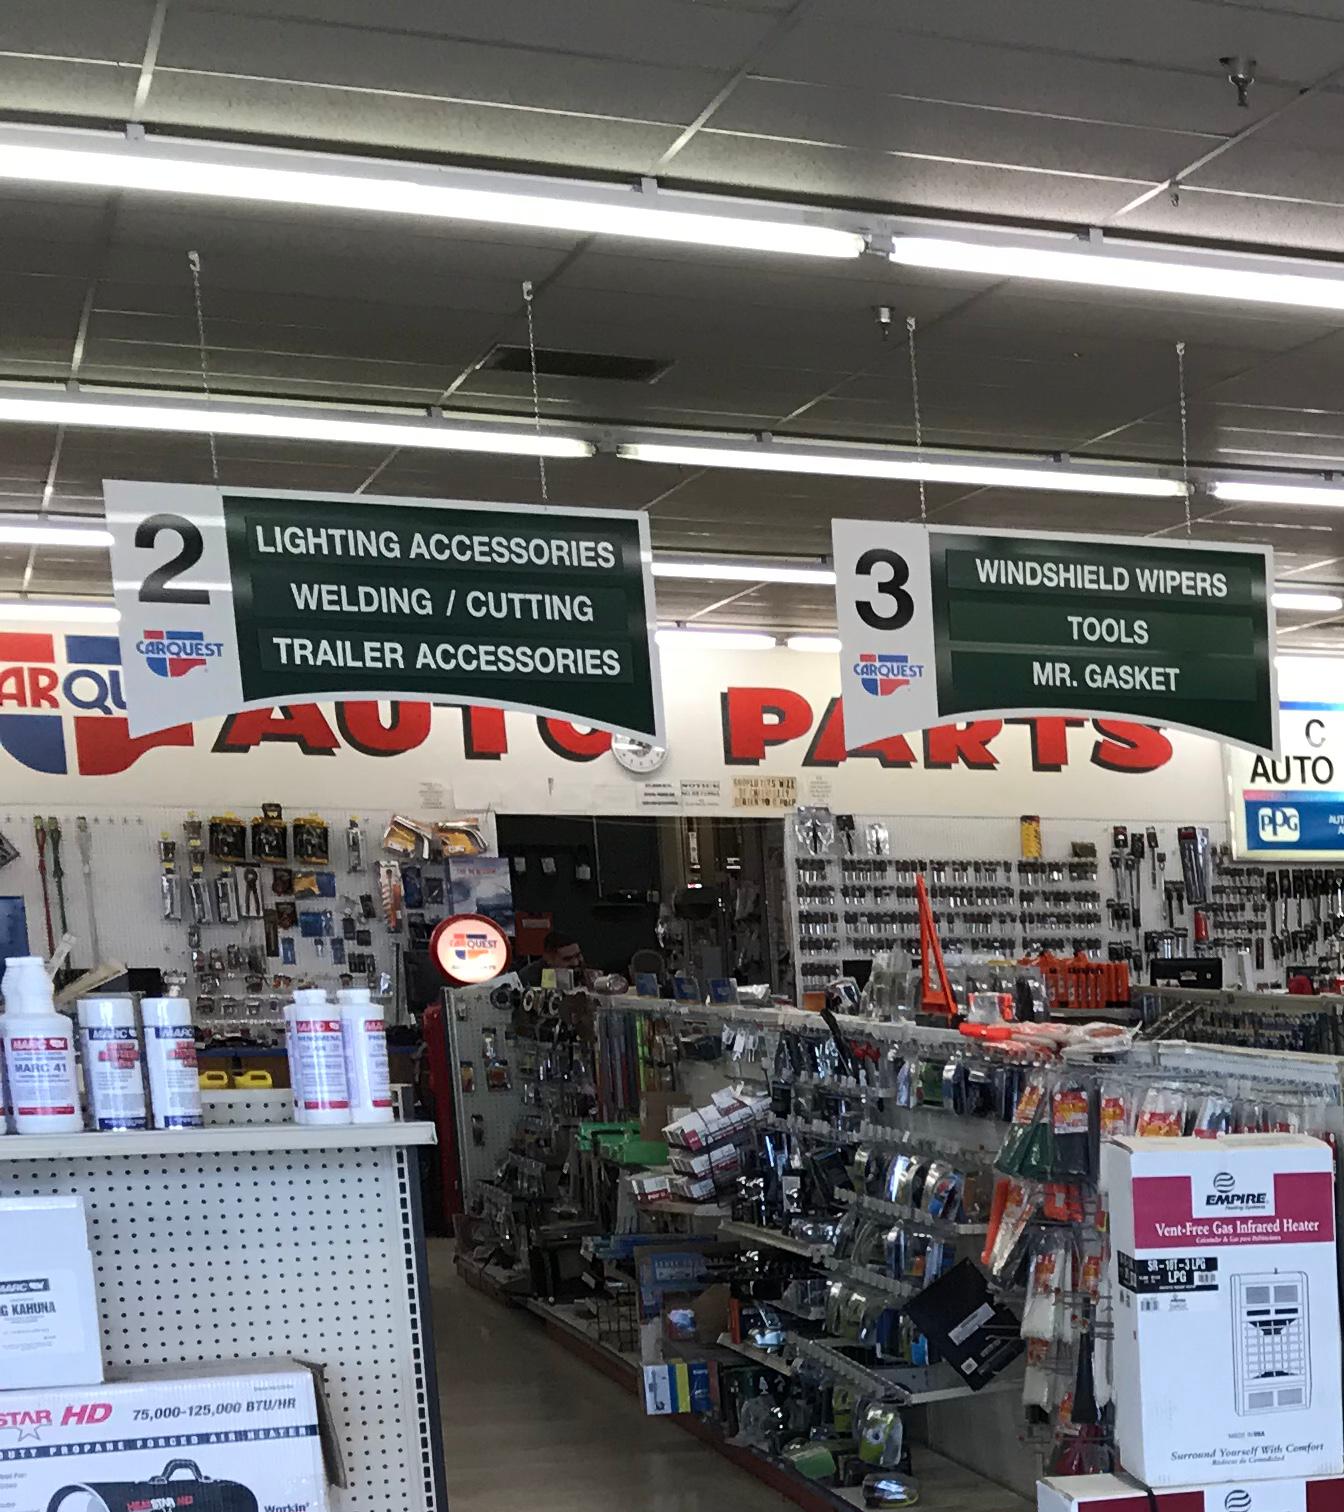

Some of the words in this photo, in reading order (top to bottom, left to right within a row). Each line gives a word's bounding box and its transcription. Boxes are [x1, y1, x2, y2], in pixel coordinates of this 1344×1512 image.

[134, 513, 210, 604] 2
[255, 525, 401, 559] LIGHTING
[409, 533, 616, 569] ACCESSORIES
[855, 549, 914, 630] 3
[975, 559, 1129, 591] WINDSHIELD
[1135, 569, 1227, 597] WIPERS
[290, 583, 432, 616] WELDING
[446, 589, 456, 617] /
[465, 590, 593, 623] CUTTING
[1068, 616, 1149, 645] TOOLS
[136, 640, 224, 658] CARQUEST
[272, 637, 404, 670] TRAILER
[415, 643, 621, 677] ACCESSORIES
[853, 663, 924, 679] CARQUEST
[1033, 661, 1078, 687] MR.
[1085, 664, 1180, 691] GASKET
[1305, 719, 1326, 747] C
[1250, 755, 1334, 785] AUTO
[1261, 808, 1299, 836] PPG
[93, 1028, 127, 1038] MARC
[15, 1063, 50, 1073] MARC
[54, 1063, 67, 1073] 41
[1206, 1193, 1266, 1206] EMPIRE
[1155, 1222, 1209, 1237] Vent-Free
[1212, 1221, 1234, 1234] Gas
[1236, 1219, 1281, 1234] Infrared
[1283, 1219, 1320, 1233] Heater
[1168, 1270, 1187, 1283] LPG
[12, 1301, 56, 1315] KAHUNA
[61, 1403, 113, 1426] HD
[132, 1402, 242, 1421] 75,000-125,000
[246, 1398, 297, 1413] BTU/HR
[50, 1441, 125, 1456] PROPANE
[136, 1435, 198, 1449] FORCED
[209, 1432, 236, 1443] AIR
[244, 1427, 307, 1440] HEATER
[1171, 1450, 1216, 1461] Surround
[1219, 1446, 1258, 1458] Yourself
[1261, 1444, 1283, 1455] With
[1286, 1442, 1324, 1453] Comfort
